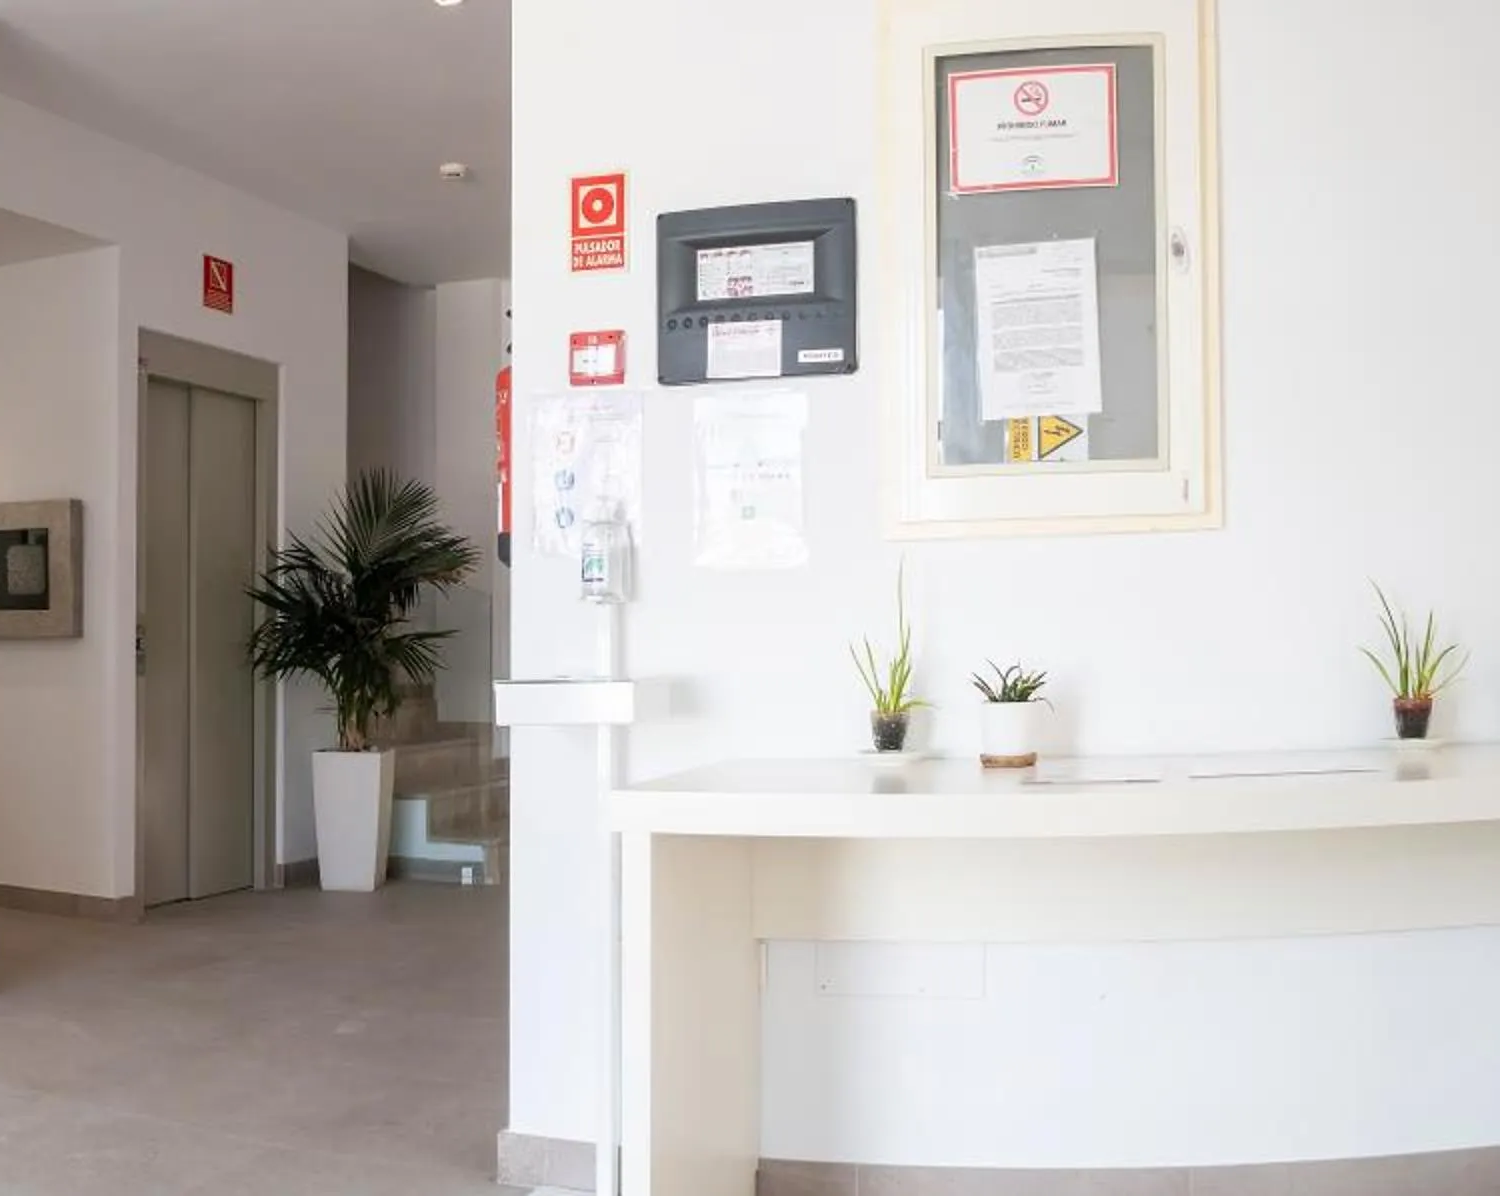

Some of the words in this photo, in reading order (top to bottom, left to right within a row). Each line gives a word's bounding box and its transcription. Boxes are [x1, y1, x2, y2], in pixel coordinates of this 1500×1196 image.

[573, 240, 620, 255] PULSADOR
[573, 256, 583, 270] DE
[585, 252, 622, 268] ALARMA
